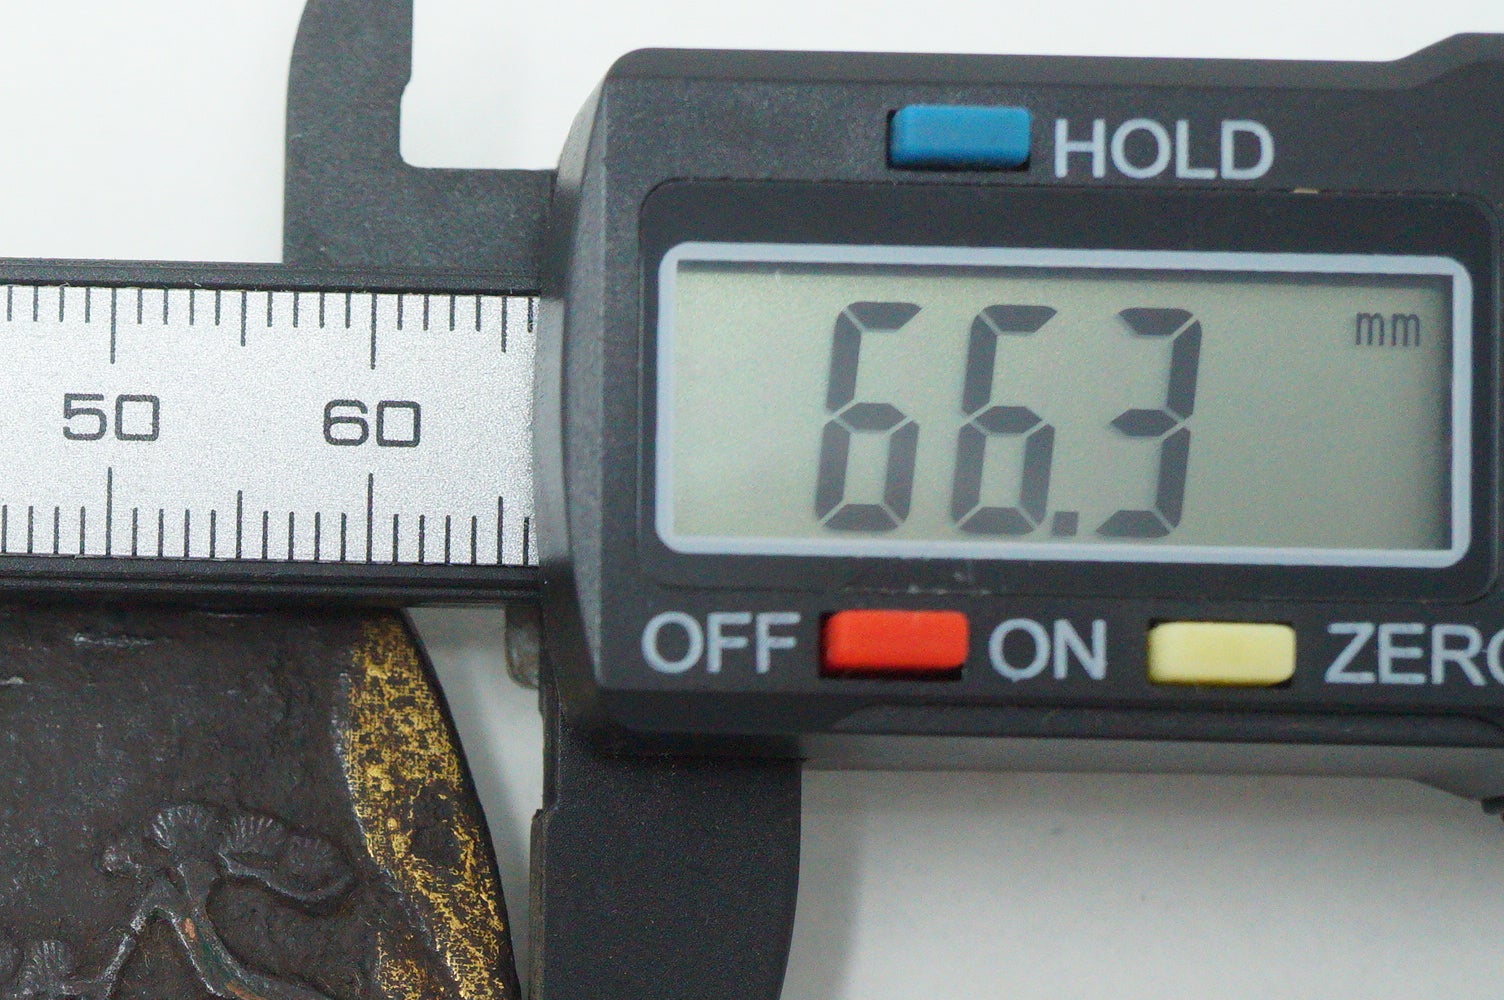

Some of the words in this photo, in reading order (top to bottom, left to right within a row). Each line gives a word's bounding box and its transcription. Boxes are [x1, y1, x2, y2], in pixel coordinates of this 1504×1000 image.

[1053, 117, 1276, 181] HOLD
[1353, 309, 1422, 347] mm
[62, 392, 161, 442] 50
[322, 398, 423, 448] 60
[815, 300, 1204, 539] 66.3
[641, 610, 802, 675] OFF
[988, 617, 1108, 683] ON
